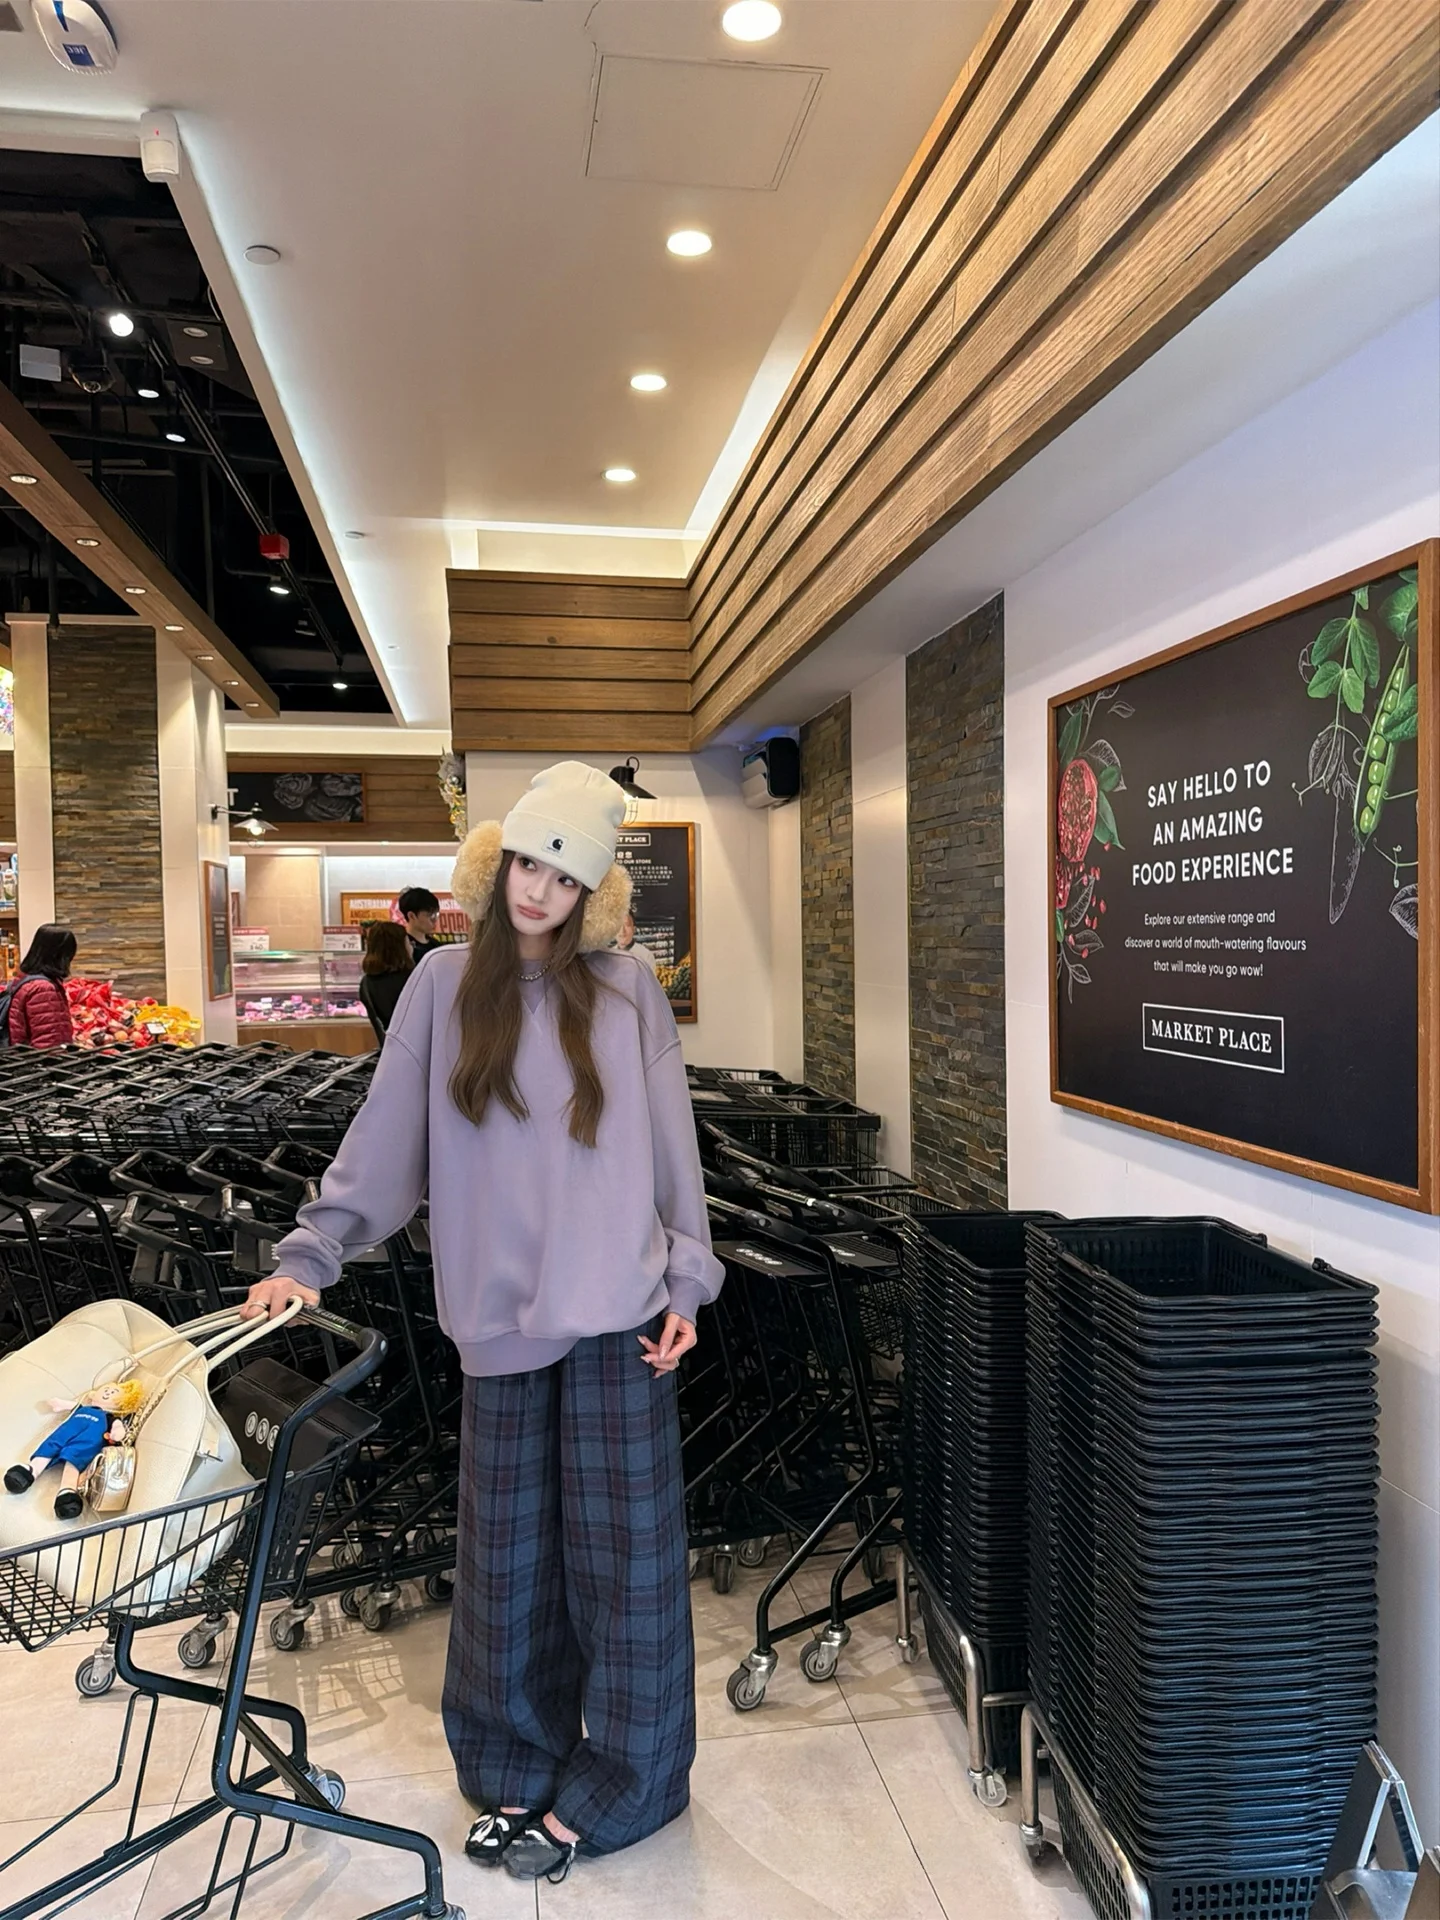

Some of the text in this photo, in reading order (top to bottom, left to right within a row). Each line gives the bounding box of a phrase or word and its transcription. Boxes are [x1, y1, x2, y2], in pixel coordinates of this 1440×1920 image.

[1148, 760, 1271, 808] SAY HELLO TO
[1153, 806, 1263, 846] AN AMAZING
[1132, 847, 1294, 886] FOOD EXPERIENCE
[1144, 910, 1276, 927] Explore our extensive range and
[1124, 936, 1307, 953] discover a world of mouth-watering flavours
[1153, 960, 1264, 978] that will make you go wow!
[1151, 1018, 1272, 1053] MARKET PLACE
